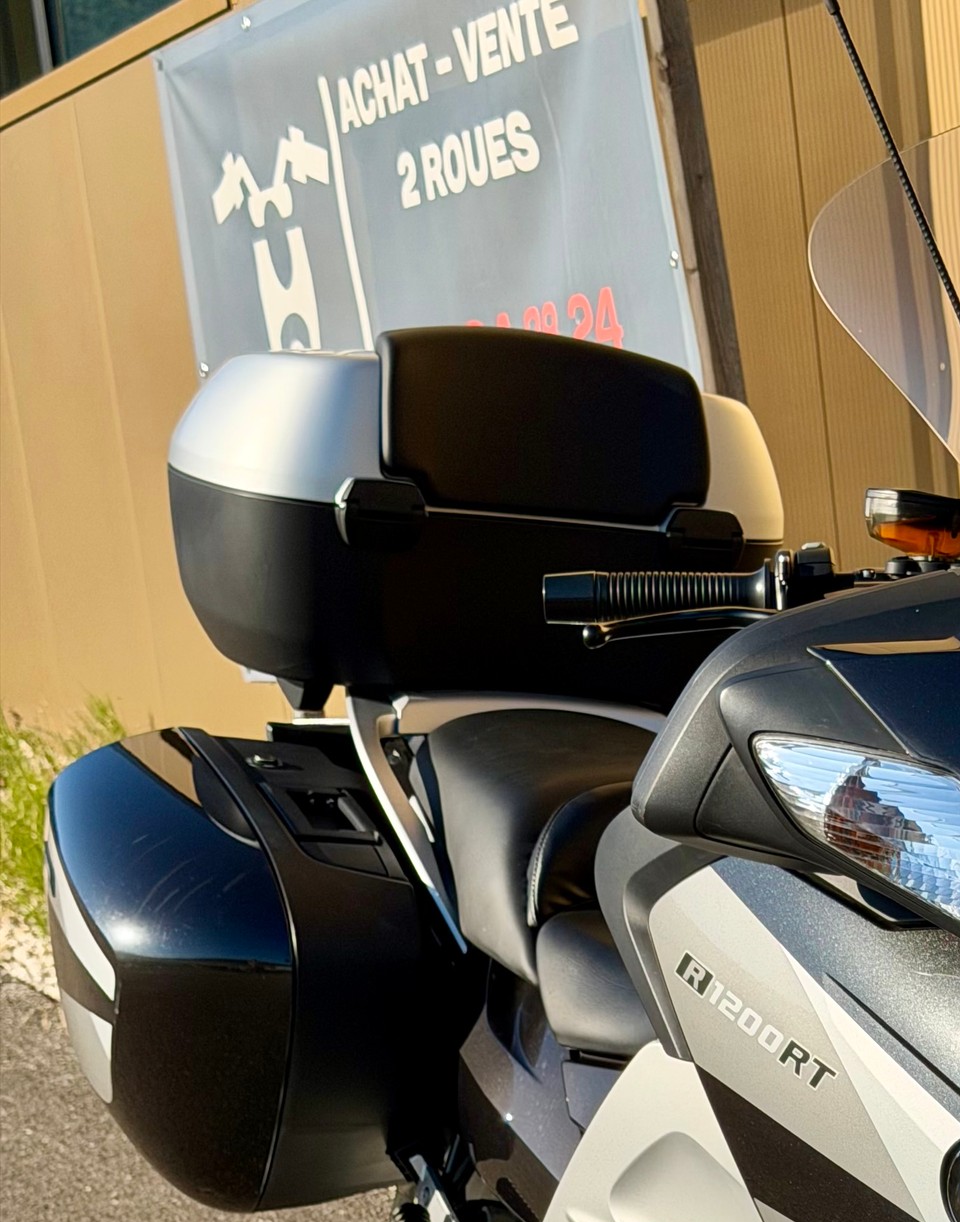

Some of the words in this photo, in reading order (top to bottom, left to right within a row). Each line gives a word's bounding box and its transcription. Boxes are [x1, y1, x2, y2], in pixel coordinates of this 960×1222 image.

[338, 43, 429, 134] ACHAT
[452, 0, 579, 83] VENTE
[397, 150, 421, 209] 2
[420, 110, 541, 201] ROUES
[566, 286, 624, 350] 24
